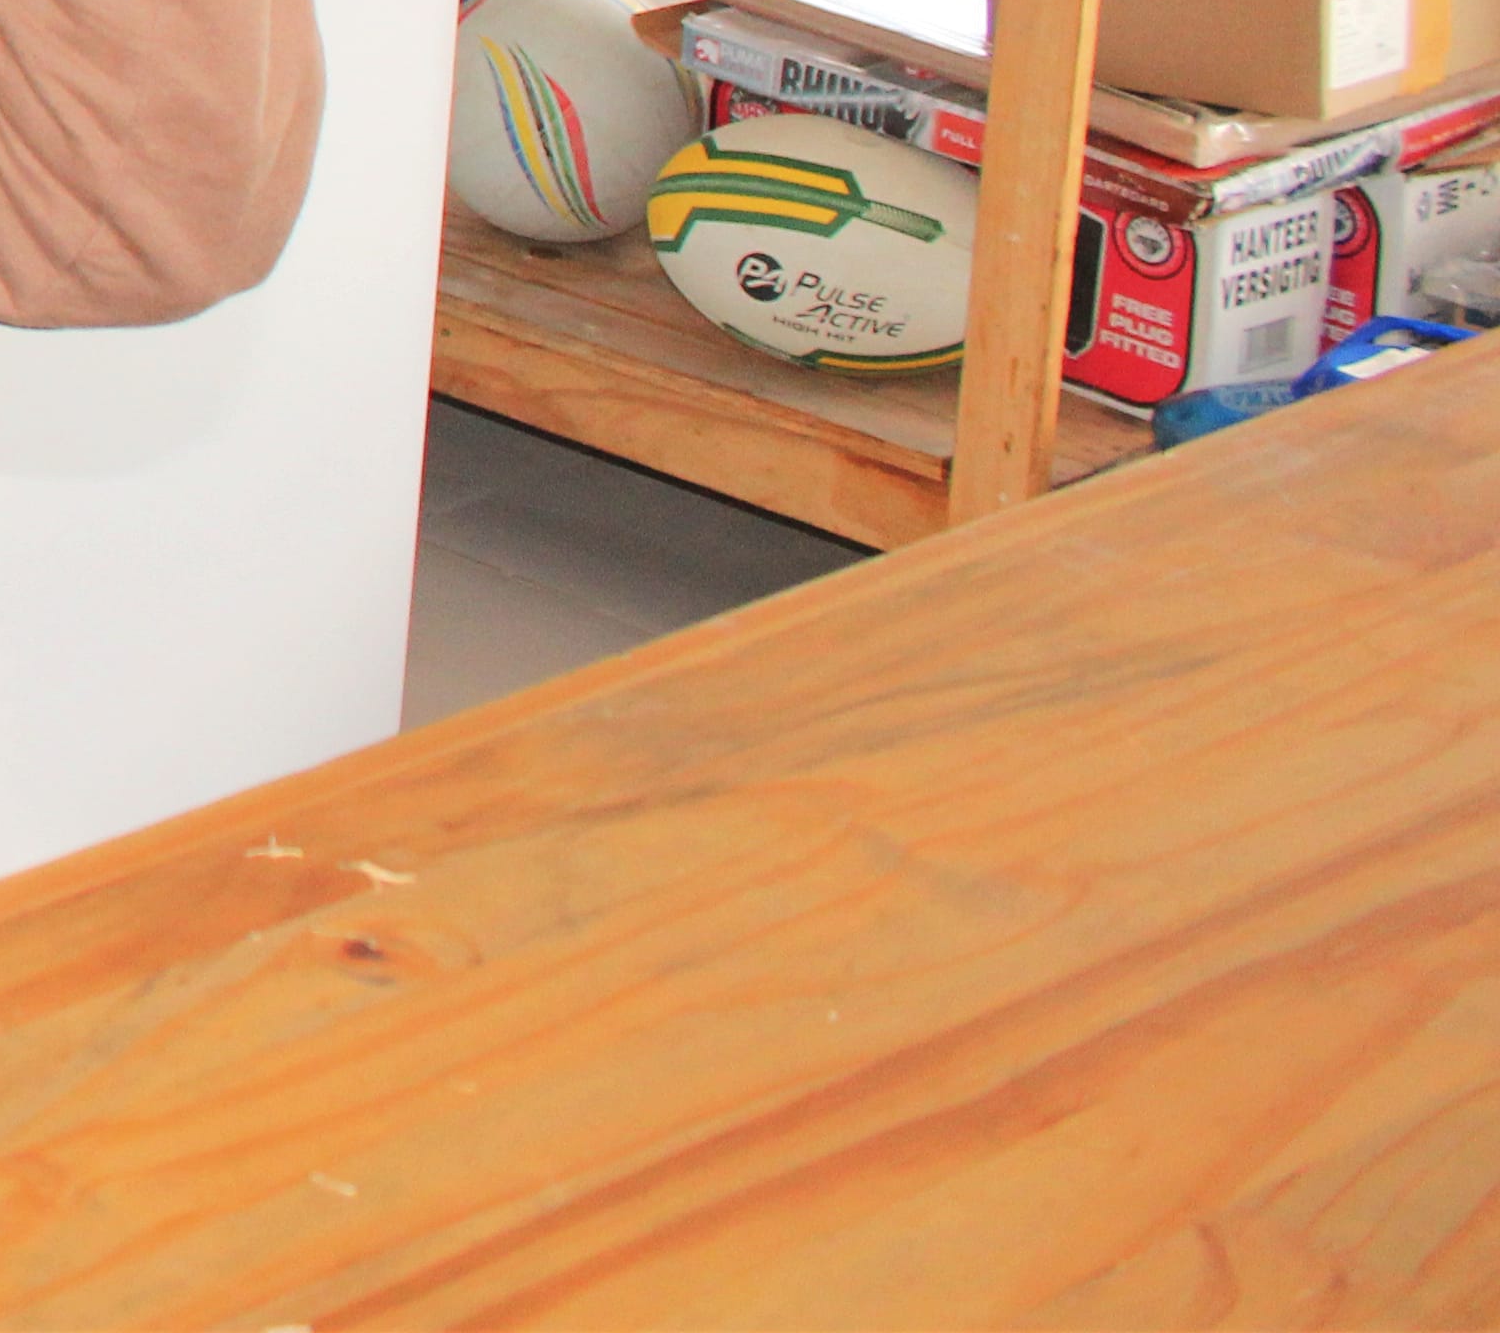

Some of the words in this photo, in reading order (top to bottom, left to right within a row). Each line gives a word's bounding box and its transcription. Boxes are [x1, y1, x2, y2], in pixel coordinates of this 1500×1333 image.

[1231, 210, 1319, 266] HANTEER
[1220, 251, 1321, 311] VERSIGTIG
[1111, 293, 1173, 327] FREE
[1107, 312, 1174, 347] PLUG
[1100, 332, 1181, 370] FITTED
